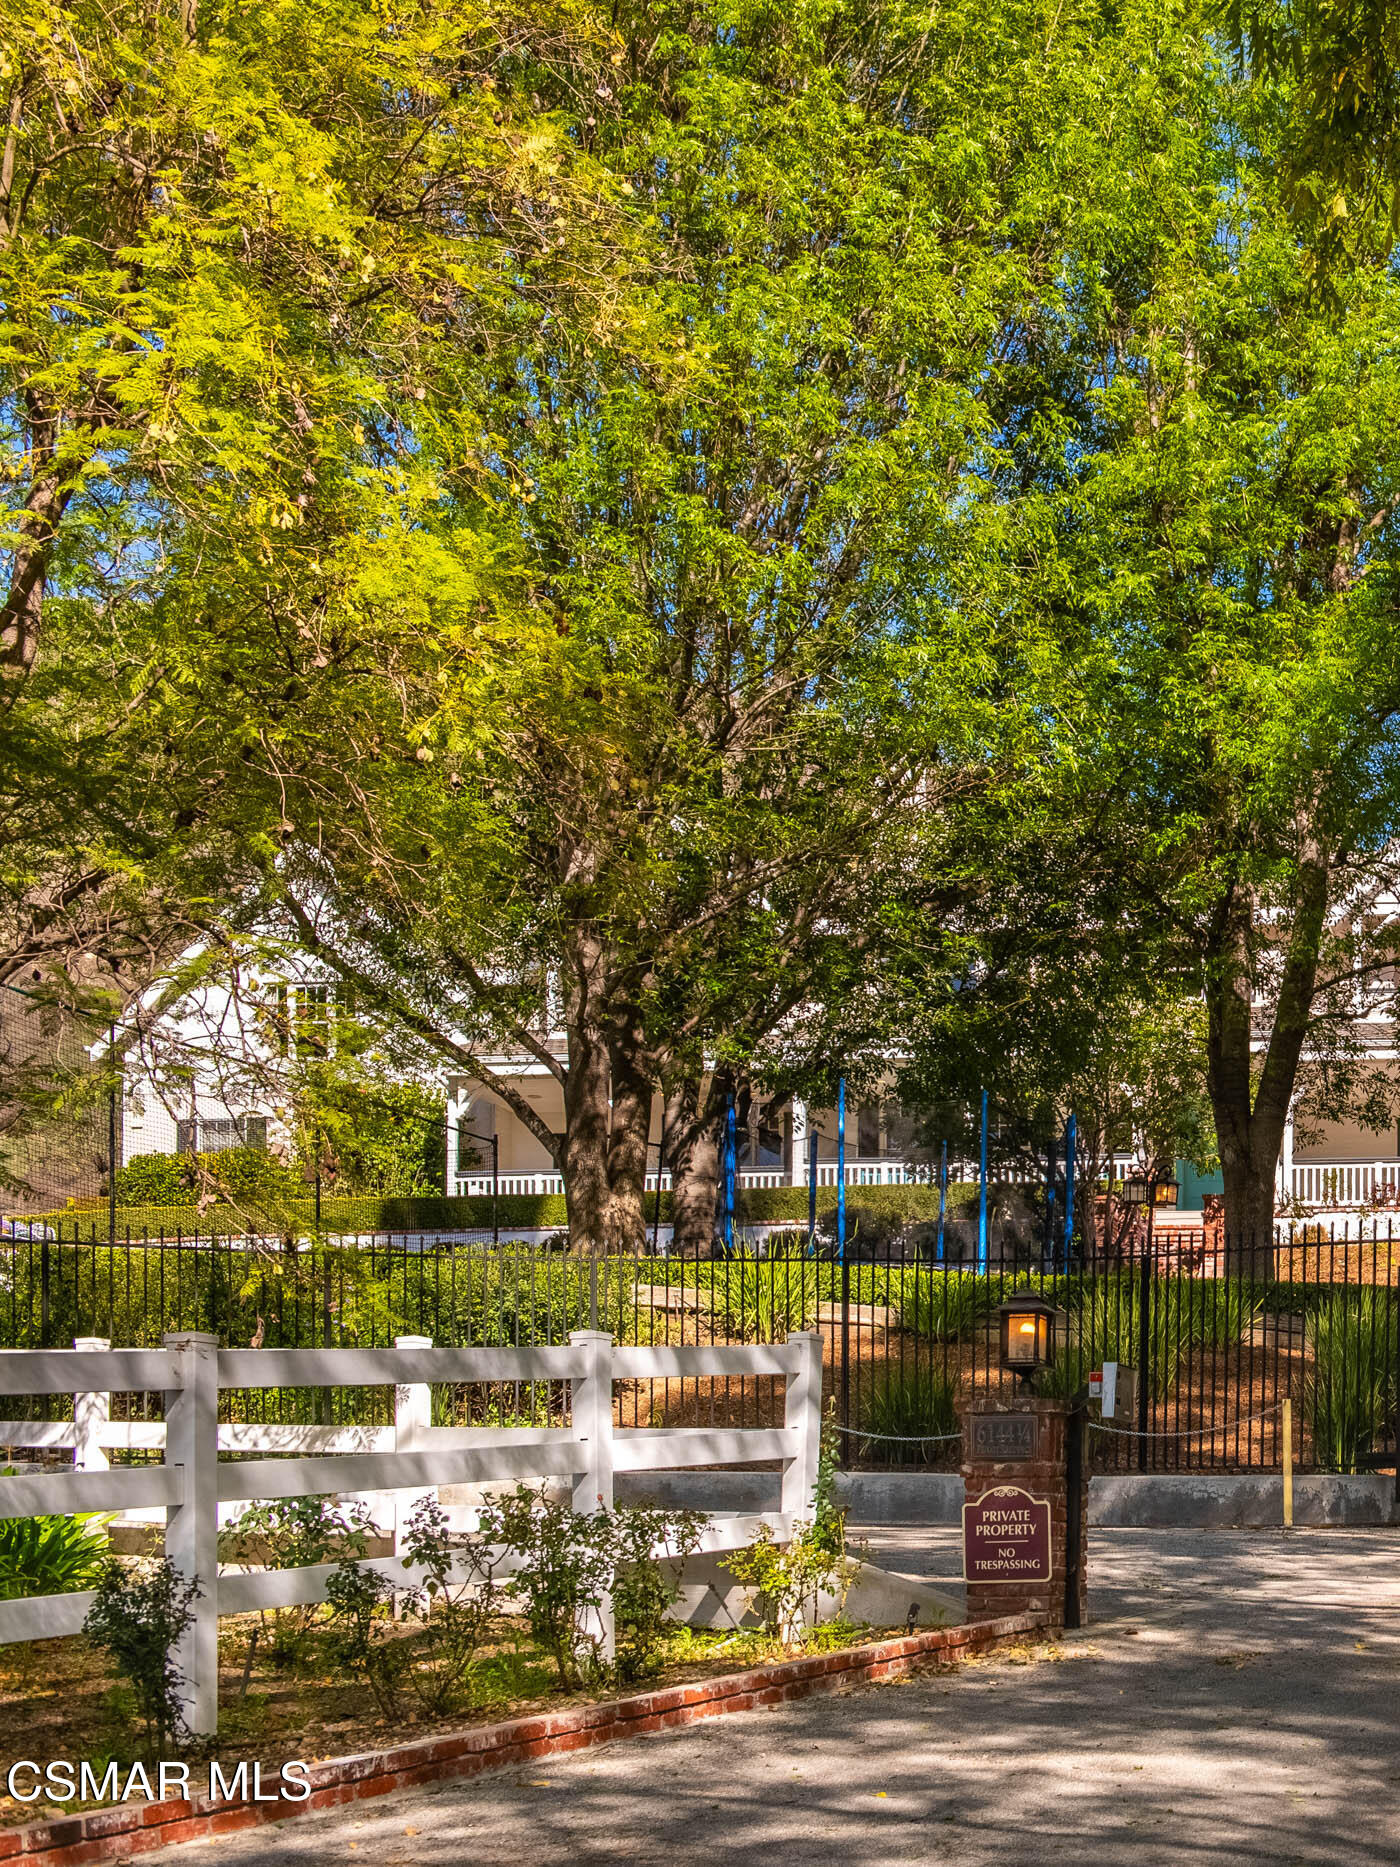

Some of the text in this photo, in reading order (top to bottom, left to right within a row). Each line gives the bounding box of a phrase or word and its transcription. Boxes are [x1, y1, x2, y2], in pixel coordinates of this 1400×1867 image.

[982, 1509, 1030, 1522] PRIVATE
[975, 1523, 1037, 1536] PROPERTY
[998, 1547, 1016, 1558] NO
[974, 1558, 1041, 1570] TRESPASSING
